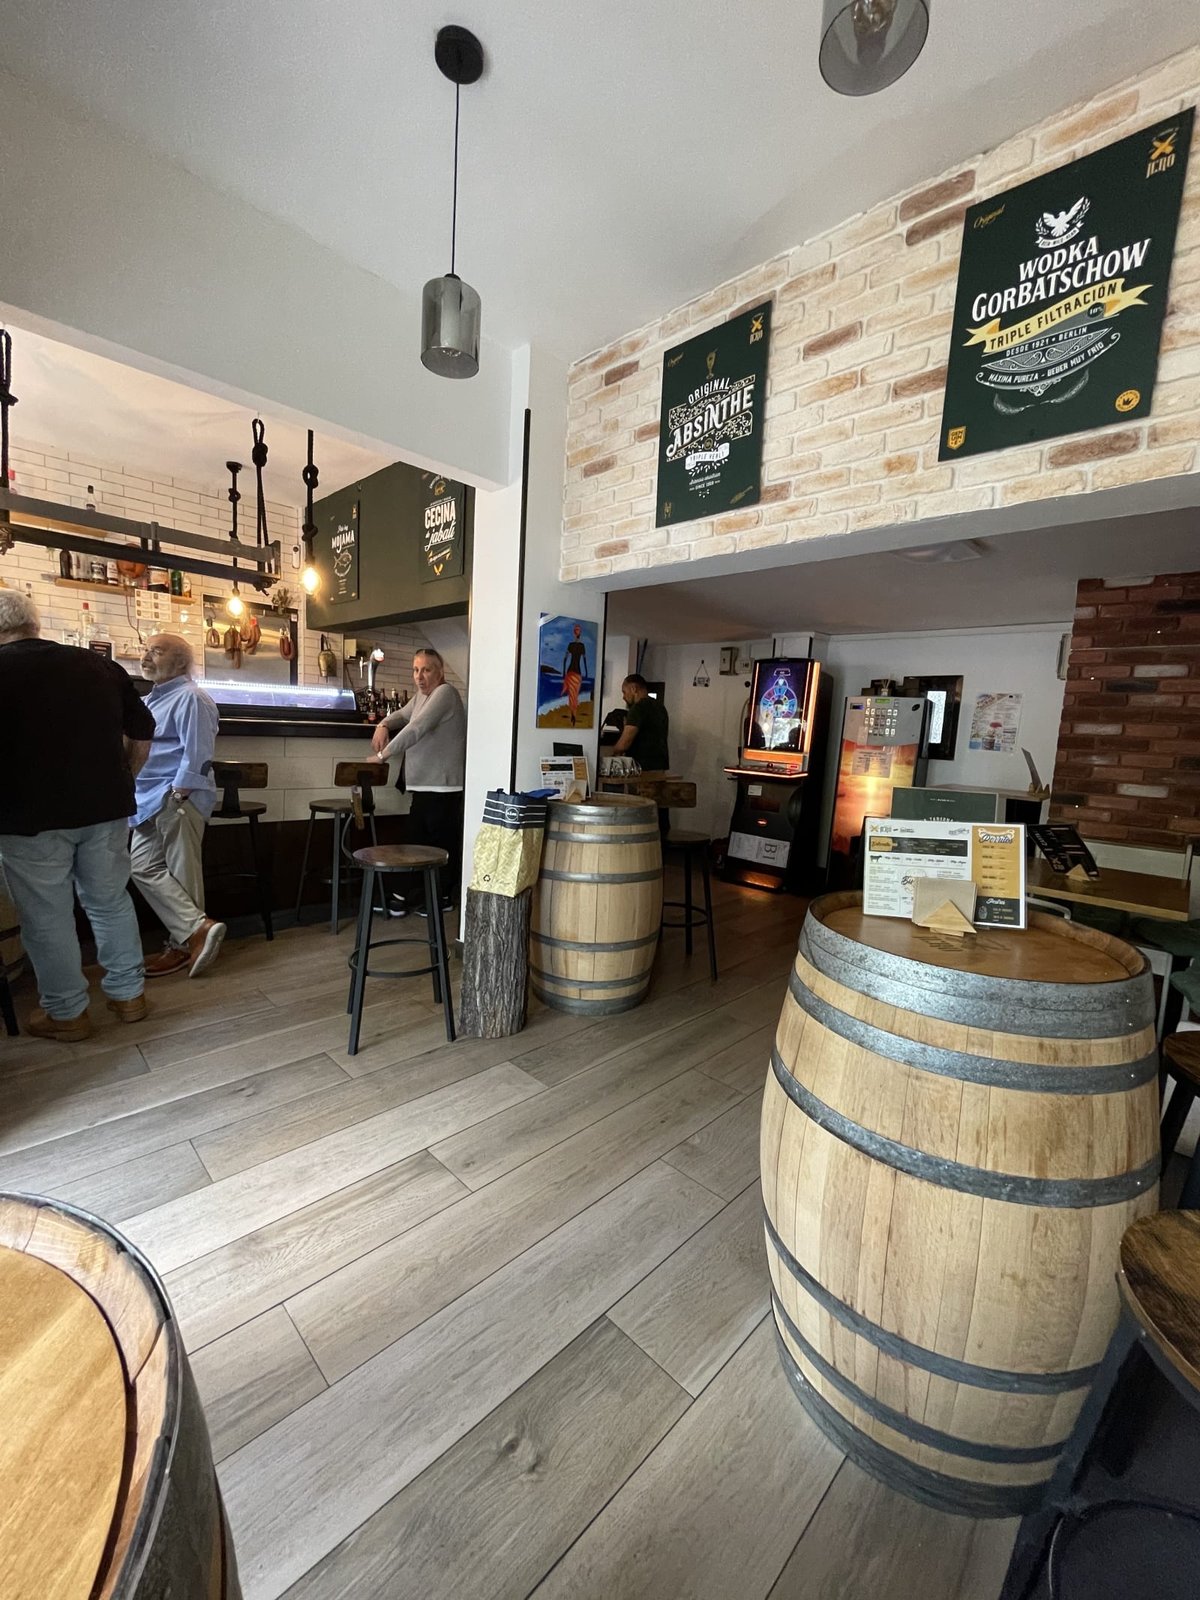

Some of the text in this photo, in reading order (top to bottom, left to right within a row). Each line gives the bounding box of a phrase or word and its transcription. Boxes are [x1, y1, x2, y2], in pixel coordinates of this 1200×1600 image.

[1019, 235, 1100, 282] WODKA
[972, 238, 1153, 322] GORBATSCHOW
[990, 281, 1117, 351] TRIPLE FILTRACIÓN
[1006, 327, 1088, 357] DESDE 1921 BERLIN
[988, 372, 1012, 384] MÁXIMA
[1013, 371, 1039, 384] PUREZA
[1047, 363, 1068, 378] BEBER
[1070, 355, 1085, 367] MUY
[688, 377, 731, 405] ORIGINAL
[666, 383, 755, 458] ABSINTHE
[425, 500, 456, 529] CECINA
[331, 529, 355, 554] MUJAMA
